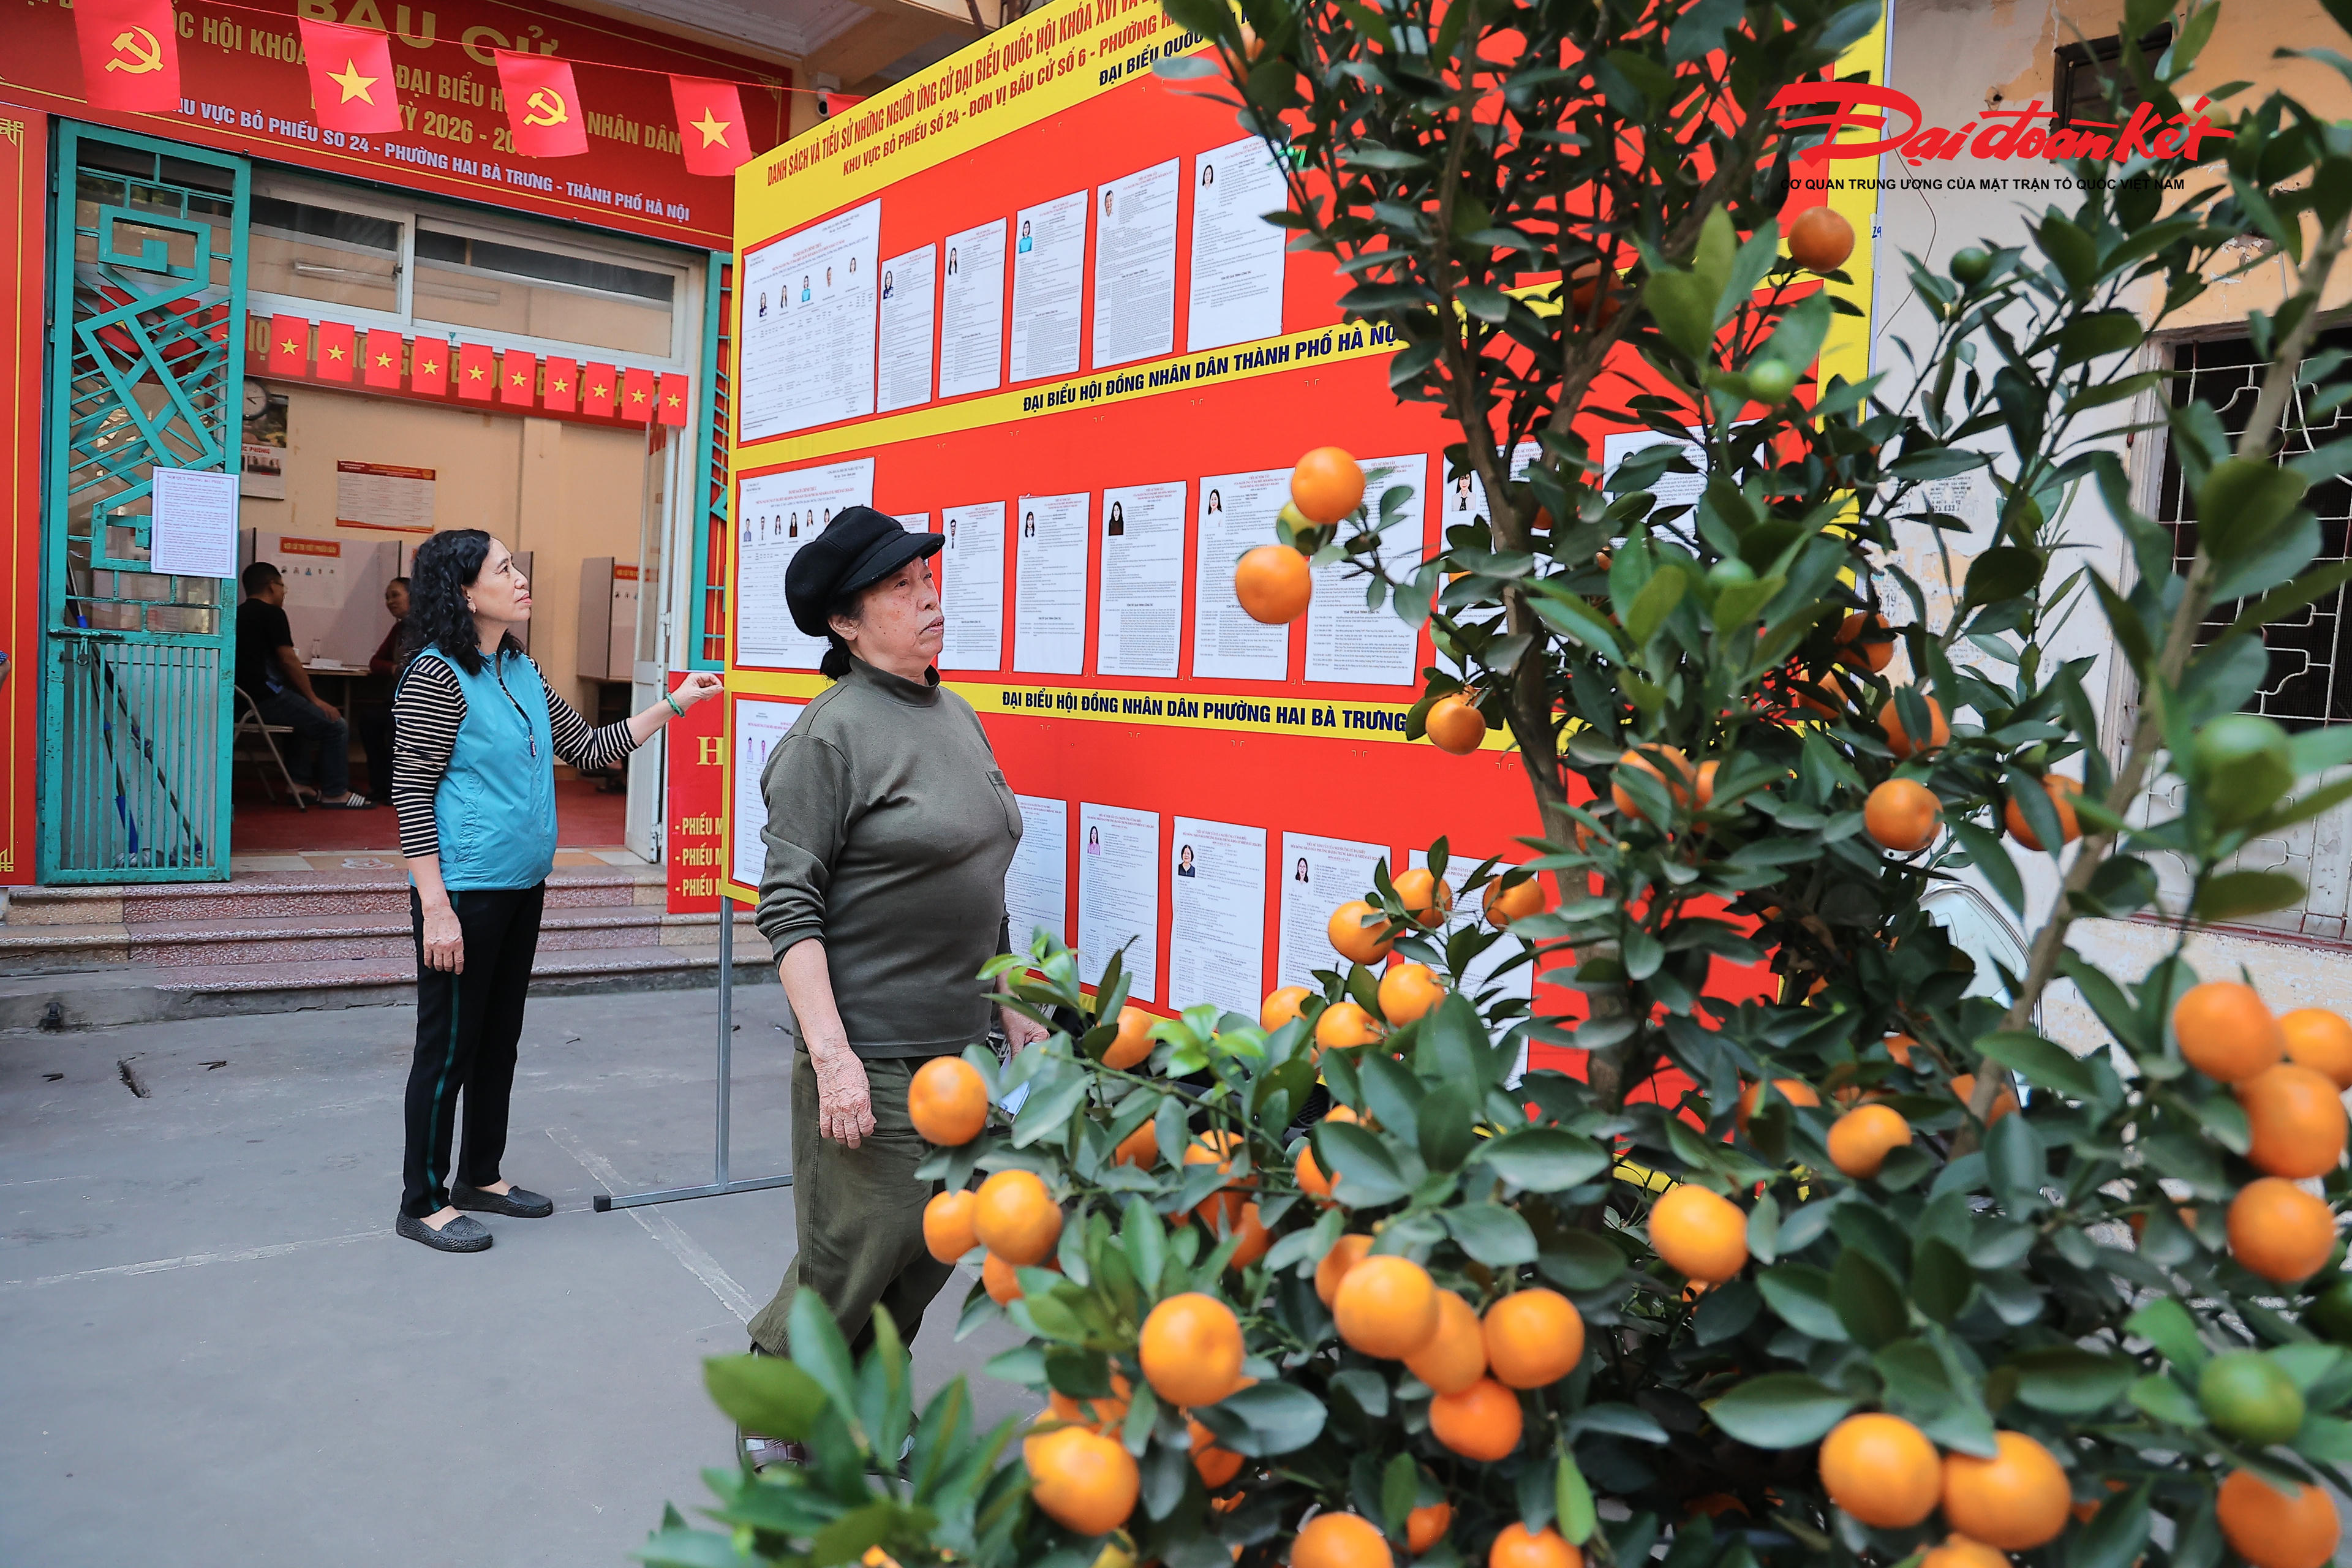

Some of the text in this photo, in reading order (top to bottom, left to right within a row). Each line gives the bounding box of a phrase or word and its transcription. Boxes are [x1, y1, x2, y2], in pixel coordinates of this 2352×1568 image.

[203, 17, 243, 53] HỘI
[396, 64, 431, 98] ĐẠI
[437, 72, 484, 107] BIỂU
[1099, 62, 1123, 87] ĐẠI
[1126, 43, 1159, 75] BIỂU
[767, 157, 786, 186] DANH
[788, 148, 809, 176] SÁCH
[810, 137, 820, 166] VÀ
[822, 124, 840, 159] TIỂU
[841, 117, 854, 150] SỬ
[854, 108, 884, 144] NHỮNG
[886, 88, 914, 128] NGƯỜI
[916, 83, 937, 112] ỨNG
[940, 66, 954, 102] CỬ
[955, 62, 973, 96] ĐẠI
[975, 42, 1000, 85] BIỂU
[1003, 26, 1033, 72] QUỐC
[1036, 18, 1056, 56] HỘI
[1059, 1, 1093, 43] KHÓA
[843, 154, 861, 176] KHU
[863, 146, 881, 167] VỰC
[883, 133, 896, 158] BỎ
[898, 120, 927, 151] PHIẾU
[930, 109, 944, 135] SỐ
[945, 108, 959, 129] 24
[969, 92, 993, 118] ĐƠN
[995, 85, 1007, 107] VỊ
[1009, 70, 1034, 99] BẦU
[1037, 58, 1056, 86] CỬ
[1057, 46, 1076, 77] SỐ
[1077, 48, 1087, 67] 6
[1099, 14, 1158, 58] PHƯỜNG
[423, 111, 473, 145] 2026
[587, 111, 682, 155] NHÂN DÂN
[200, 102, 235, 124] VỰC
[240, 109, 264, 130] BỎ
[268, 118, 318, 142] PHIẾU
[349, 135, 369, 153] 24
[384, 141, 448, 170] PHƯỜNG
[452, 158, 478, 176] HAI
[481, 163, 502, 181] BÀ
[505, 168, 553, 192] TRƯNG
[566, 181, 611, 205] THÀNH
[614, 193, 643, 211] PHỐ
[645, 199, 663, 216] HÀ
[666, 203, 690, 223] NỘI
[1023, 394, 1043, 413] ĐẠI
[1047, 382, 1076, 407] BIỂU
[1079, 380, 1102, 404] HỘI
[1106, 372, 1144, 396] ĐỒNG
[1148, 363, 1191, 388] NHÂN
[1195, 356, 1229, 379] DÂN
[1234, 346, 1289, 371] THÀNH
[1295, 330, 1333, 360] PHỐ
[1338, 326, 1364, 352] HÀ
[1002, 687, 1407, 732] ĐẠI BIỂU HỘI ĐỒNG NHÂN DÂN PHƯỜNG HAI BÀ TRƯNG
[682, 811, 713, 835] PHIẾU
[682, 842, 713, 866] PHIẾU
[682, 872, 713, 897] PHIẾU
